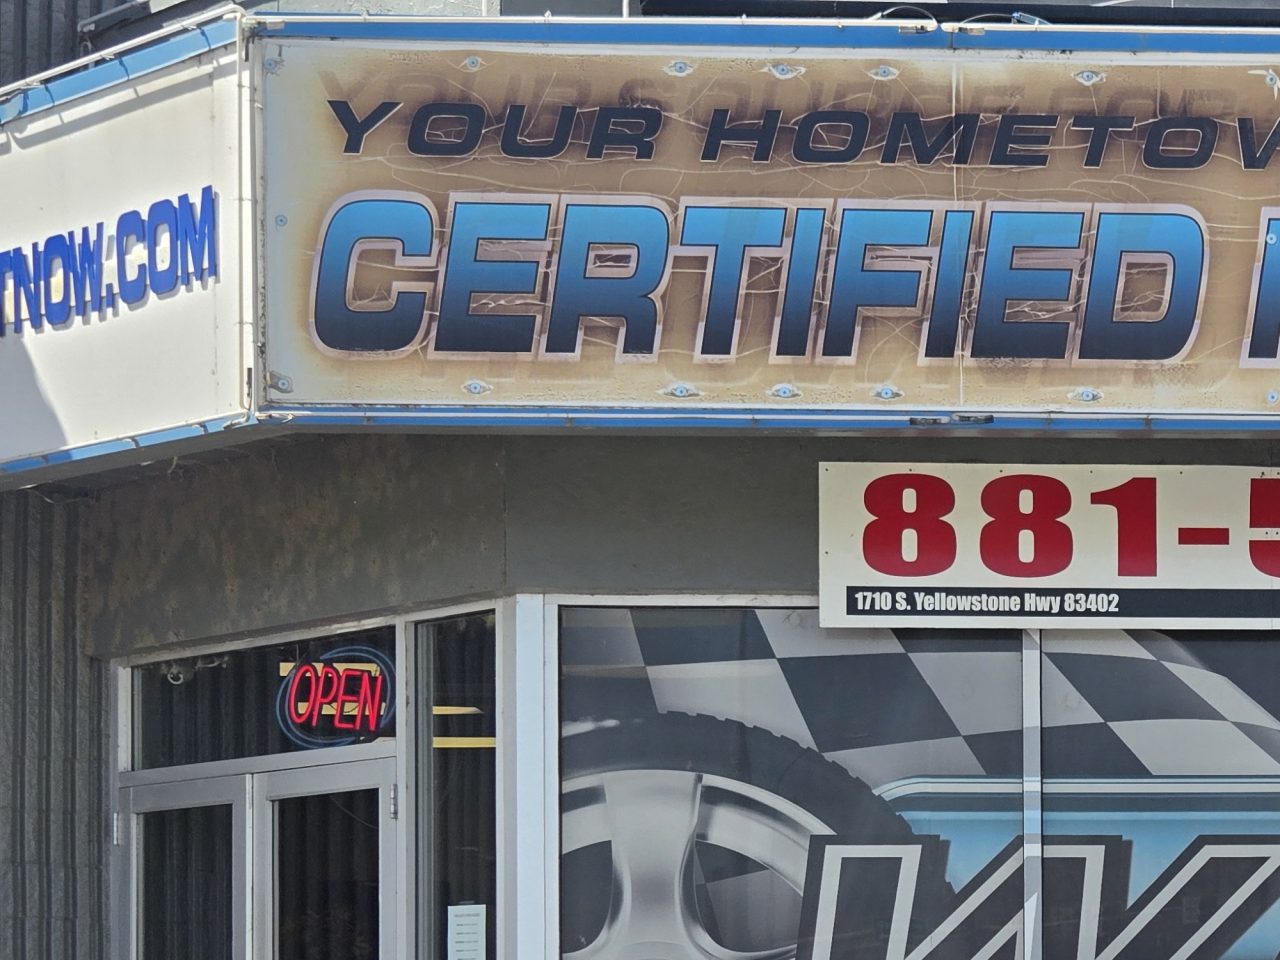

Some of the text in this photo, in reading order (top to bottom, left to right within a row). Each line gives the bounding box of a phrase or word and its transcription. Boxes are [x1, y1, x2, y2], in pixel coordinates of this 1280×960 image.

[327, 99, 664, 161] YOUR
[310, 191, 1207, 367] CERTIFIED
[855, 591, 1119, 613] 1710 S. Yellowstone Hwy 83402
[289, 664, 383, 731] OPEN
